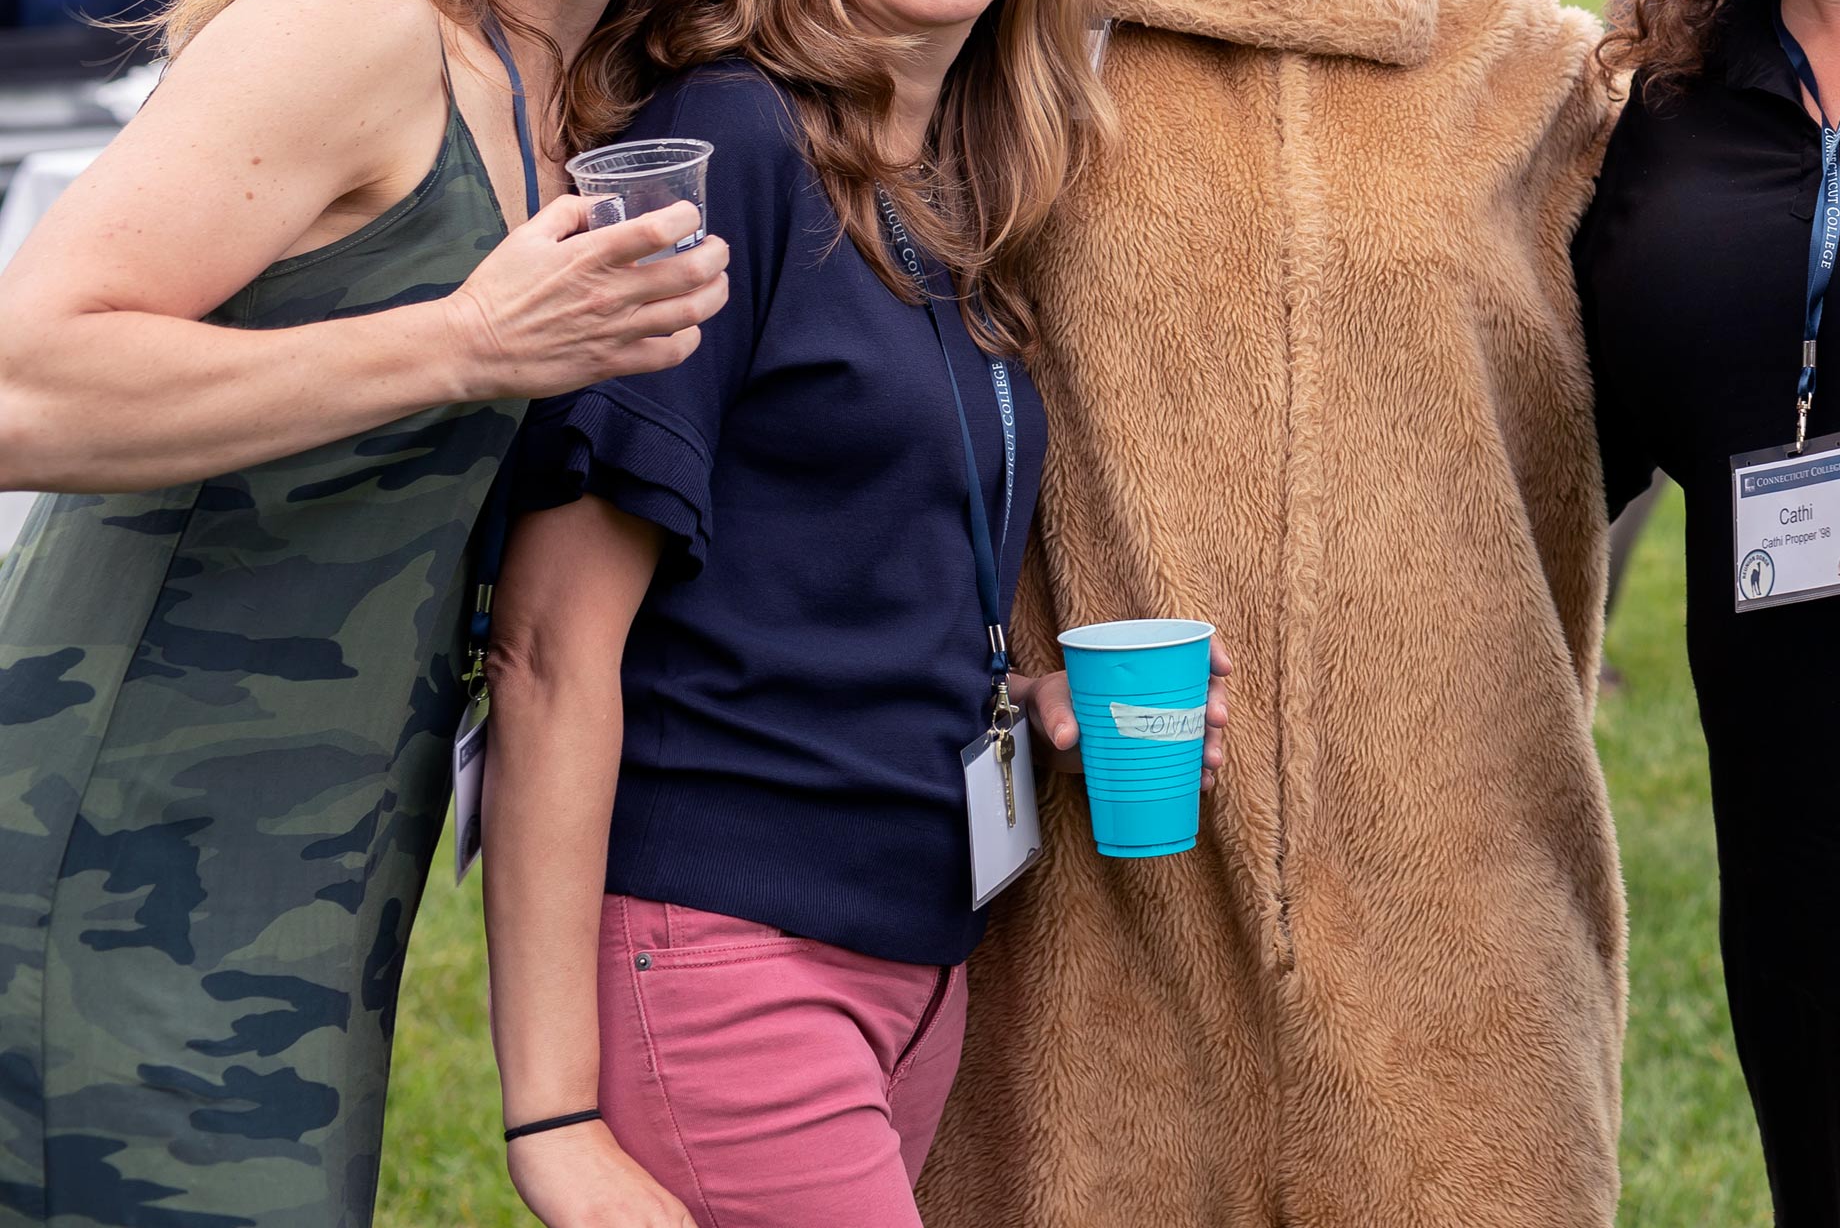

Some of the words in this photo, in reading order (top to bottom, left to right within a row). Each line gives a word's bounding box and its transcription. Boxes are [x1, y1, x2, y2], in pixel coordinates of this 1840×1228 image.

[1821, 206, 1840, 269] COLLEGE
[992, 361, 1014, 427] COLLEGE
[1756, 469, 1810, 488] CONNECTICUT
[1779, 503, 1813, 525] Cathi
[1762, 535, 1783, 550] Cathi
[1785, 530, 1817, 546] Propper
